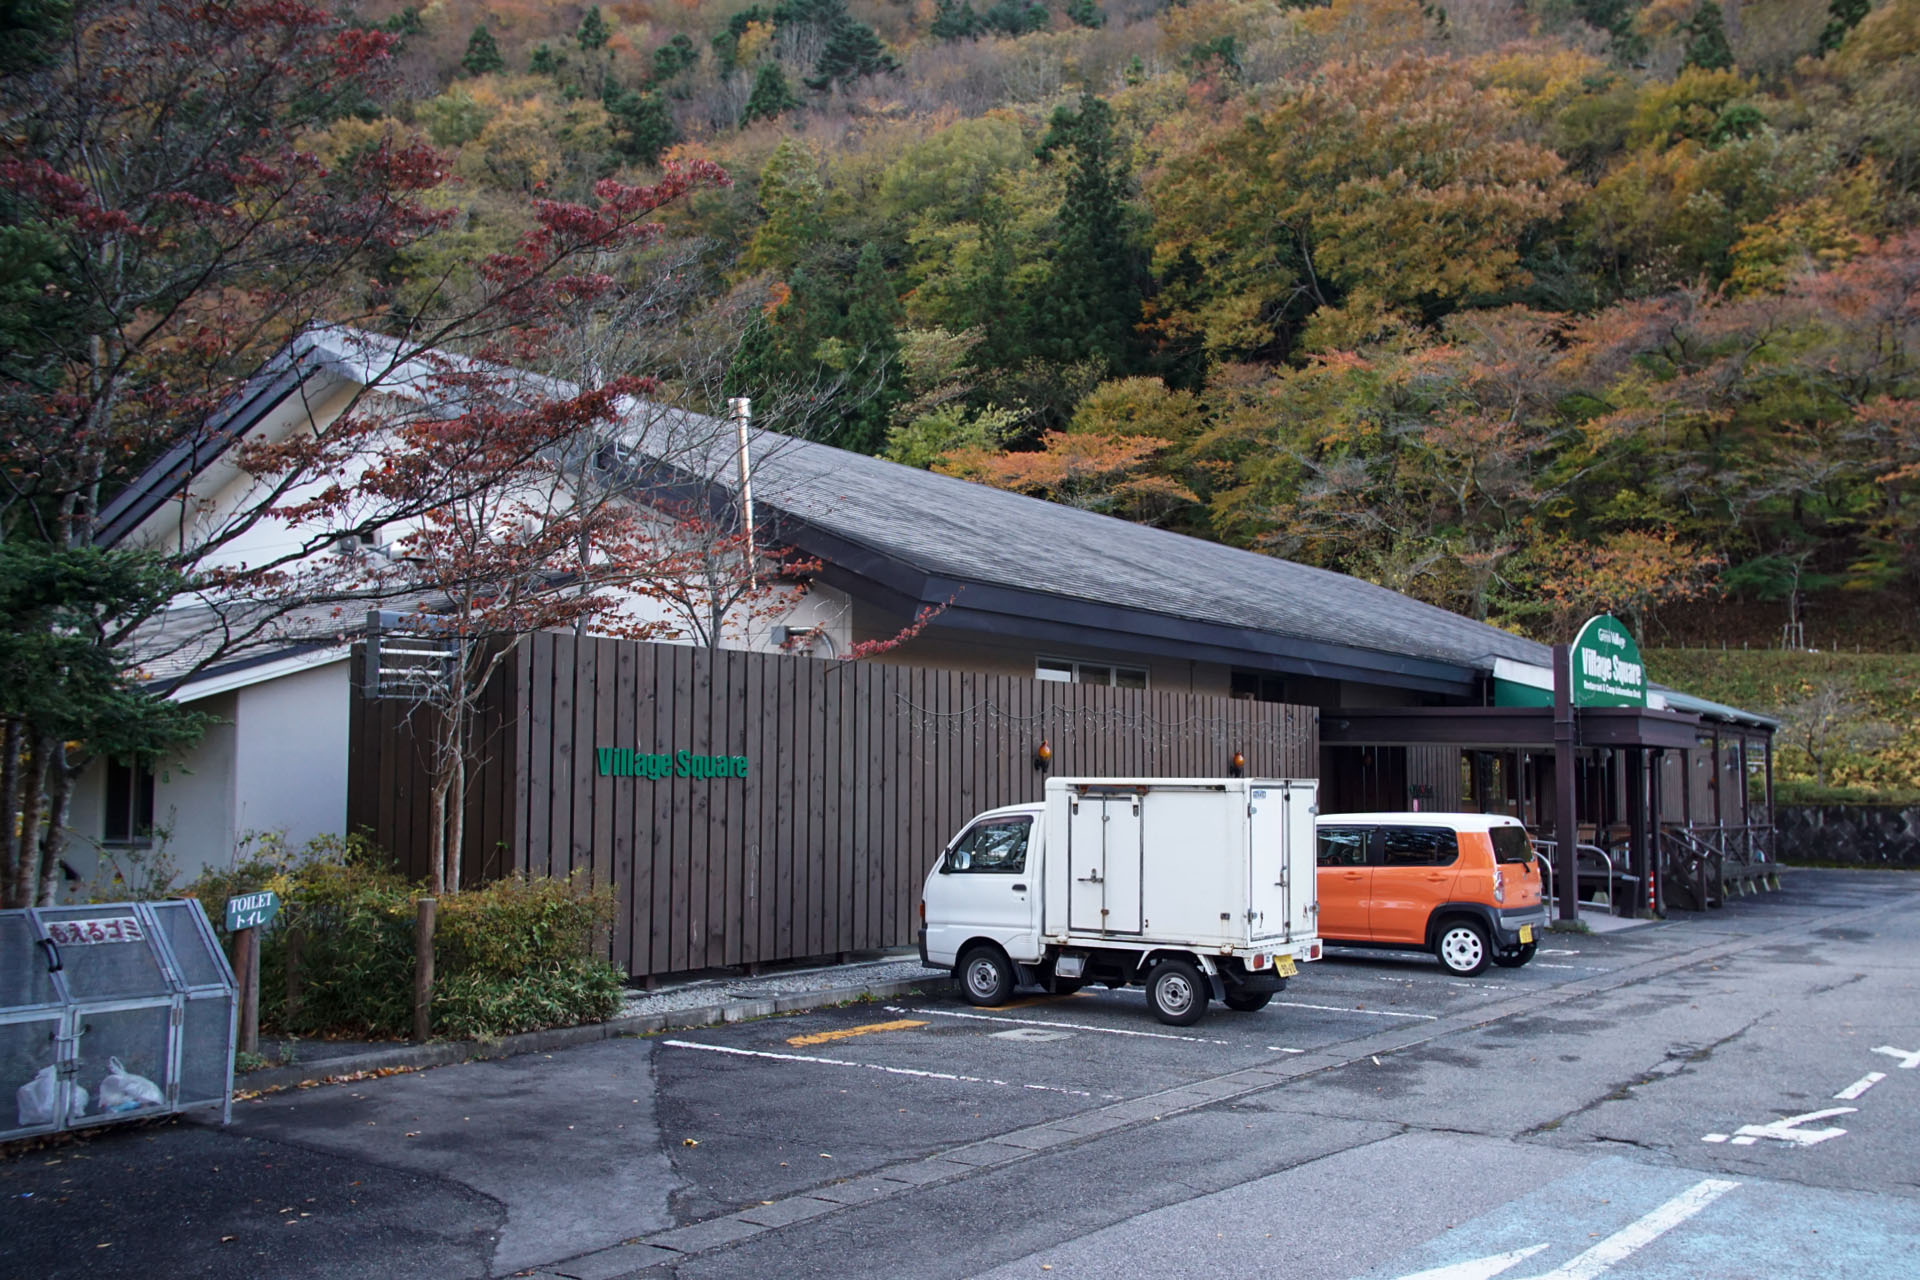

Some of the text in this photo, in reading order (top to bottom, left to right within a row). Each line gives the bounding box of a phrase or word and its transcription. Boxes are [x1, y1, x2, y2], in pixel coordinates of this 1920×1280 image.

[1582, 647, 1641, 686] Village Square
[597, 747, 748, 781] Village Square
[230, 892, 273, 913] TOILET
[48, 920, 142, 943] もえるゴミ
[236, 911, 266, 929] トイレ
